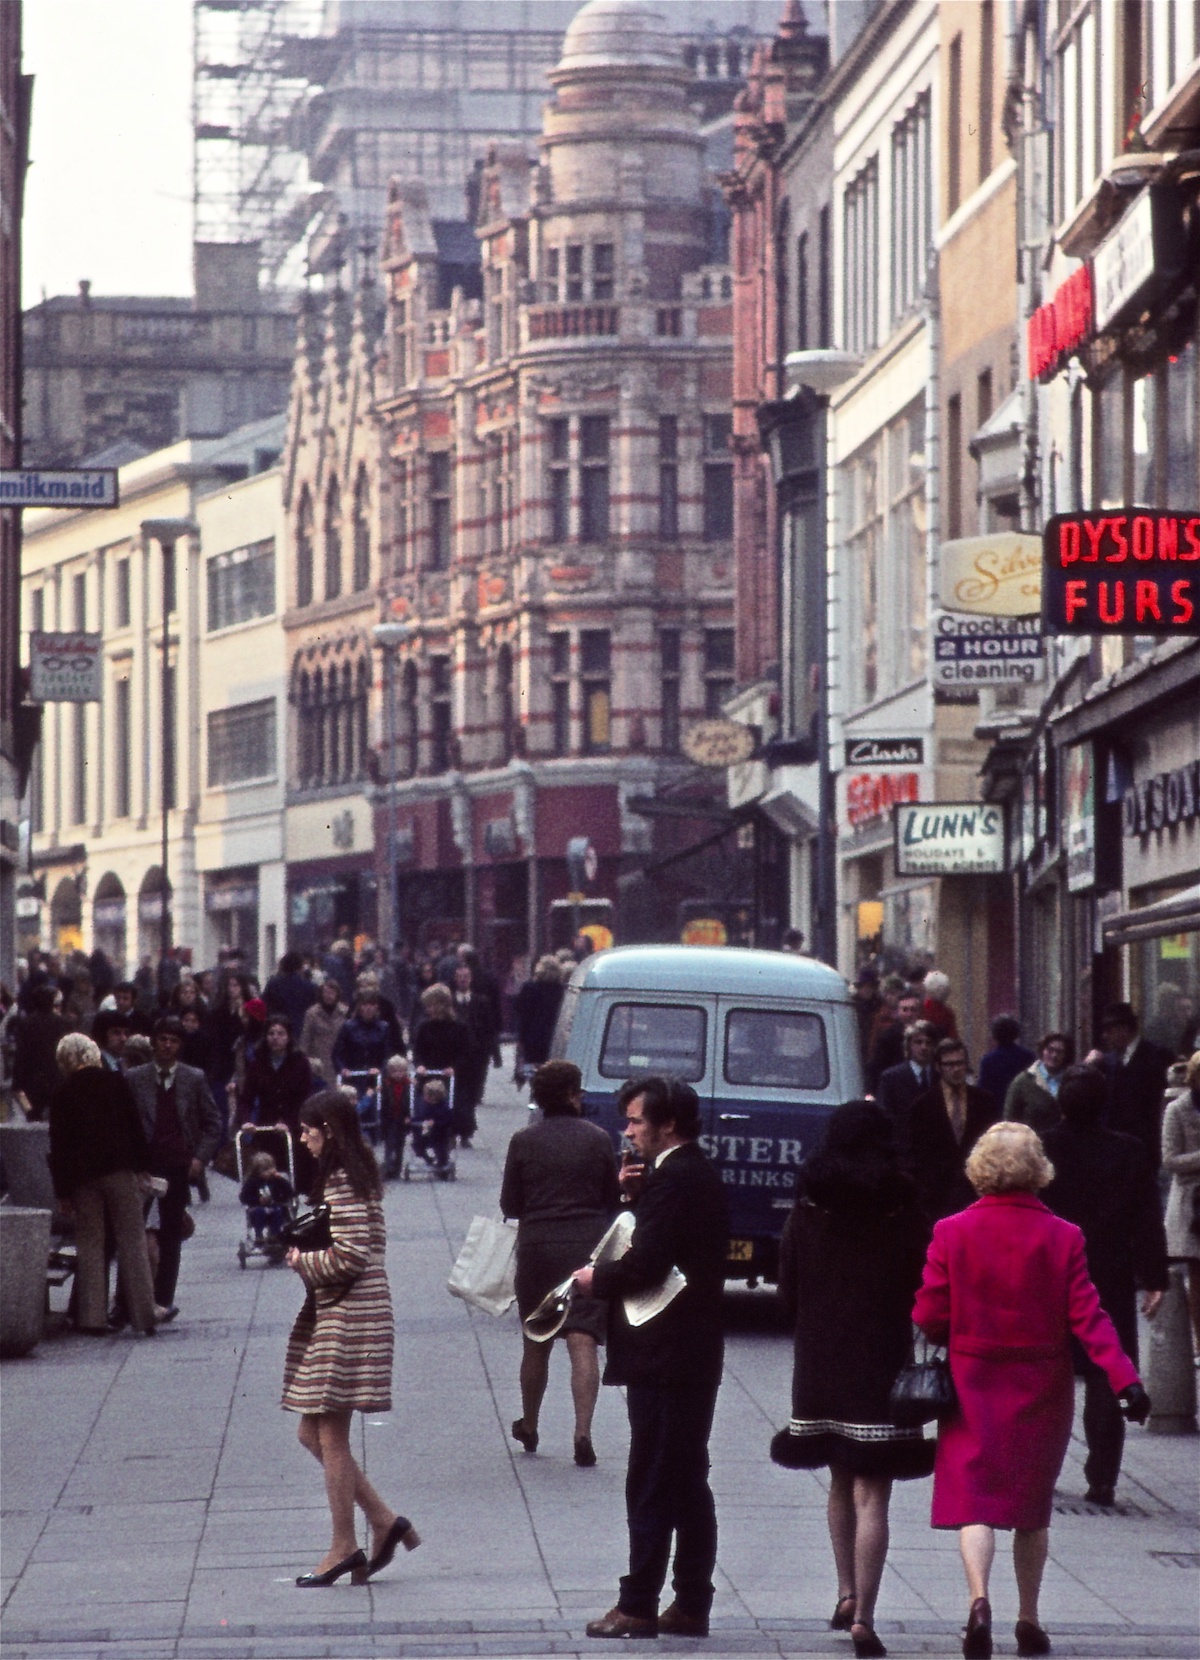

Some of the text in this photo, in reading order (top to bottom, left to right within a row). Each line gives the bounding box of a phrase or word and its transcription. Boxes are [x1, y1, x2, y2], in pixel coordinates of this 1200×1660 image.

[0, 473, 105, 498] milkmaid
[1065, 580, 1193, 623] FURS
[938, 638, 1038, 656] 2 HOUR
[941, 660, 1036, 683] cleaning
[904, 805, 999, 846] LUNN'S
[722, 1171, 795, 1187] RINKS
